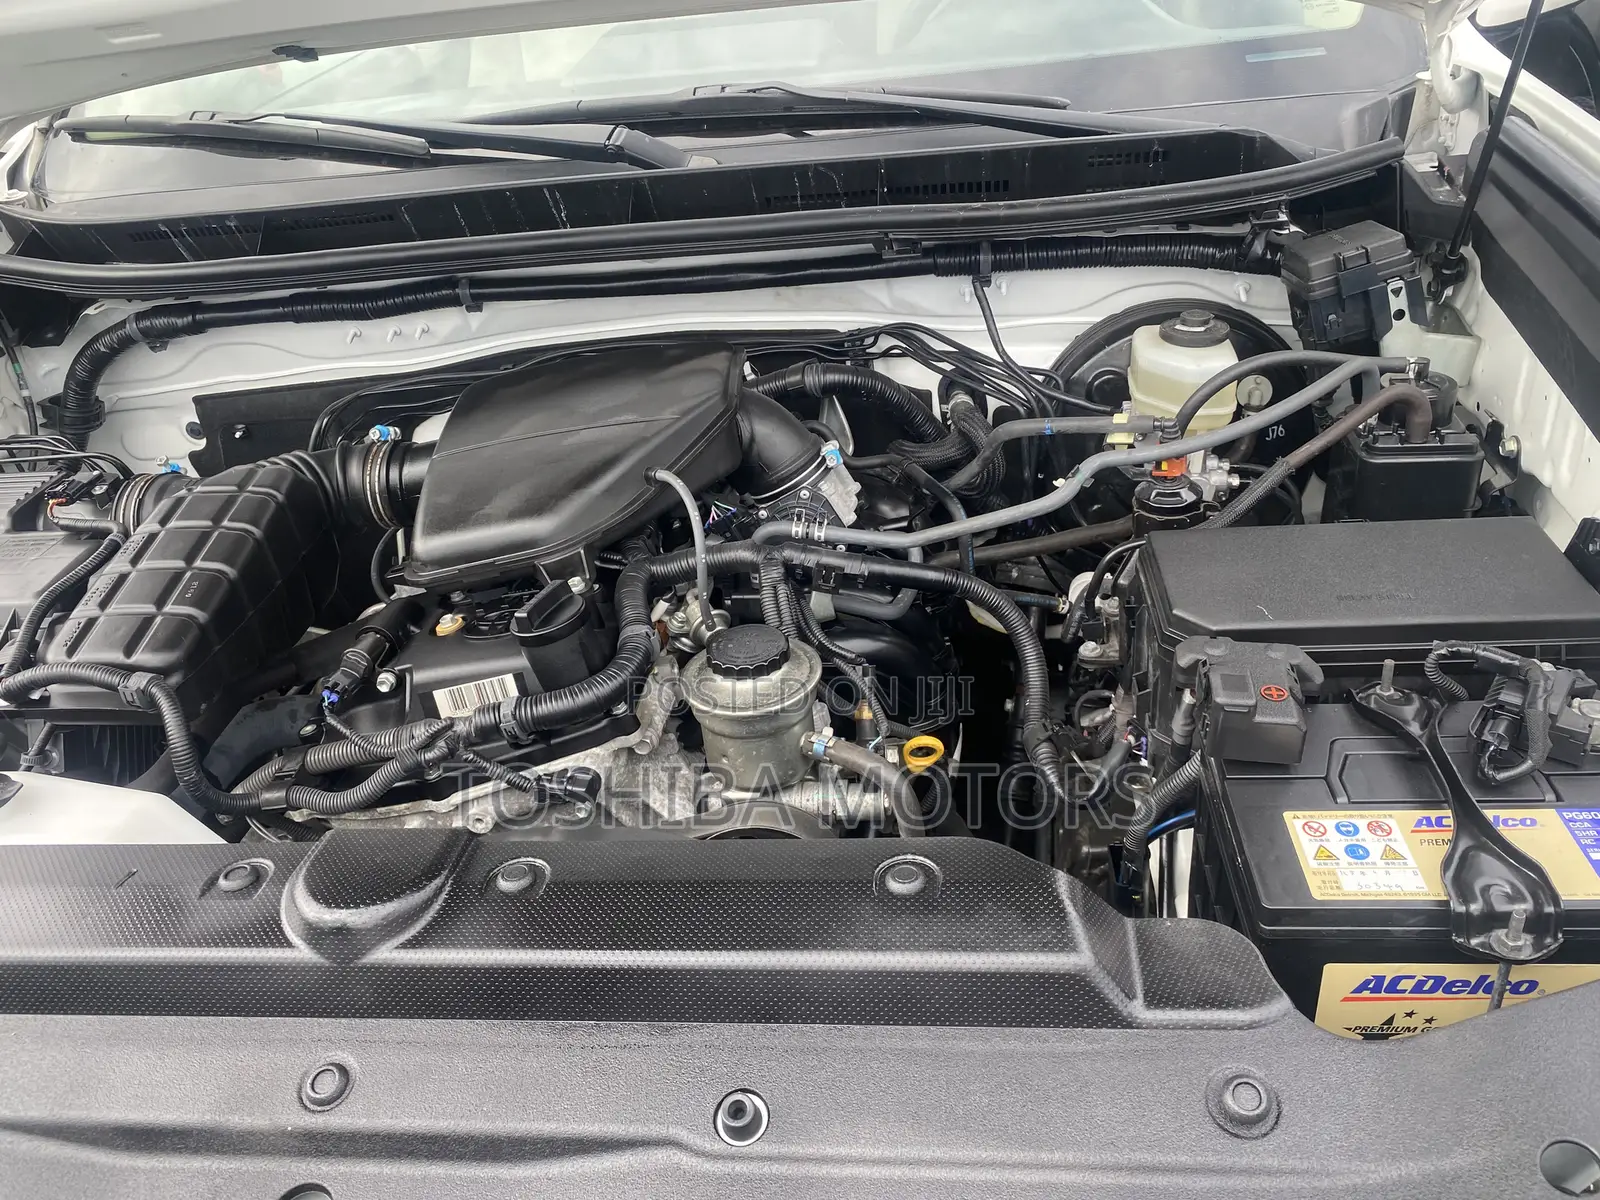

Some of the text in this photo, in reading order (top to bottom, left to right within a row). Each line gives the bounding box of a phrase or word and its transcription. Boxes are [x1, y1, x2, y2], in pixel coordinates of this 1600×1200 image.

[1265, 424, 1285, 440] J76
[1420, 838, 1452, 846] PREM
[1350, 975, 1540, 995] ACDelco
[1352, 1025, 1418, 1034] PREMIUM
